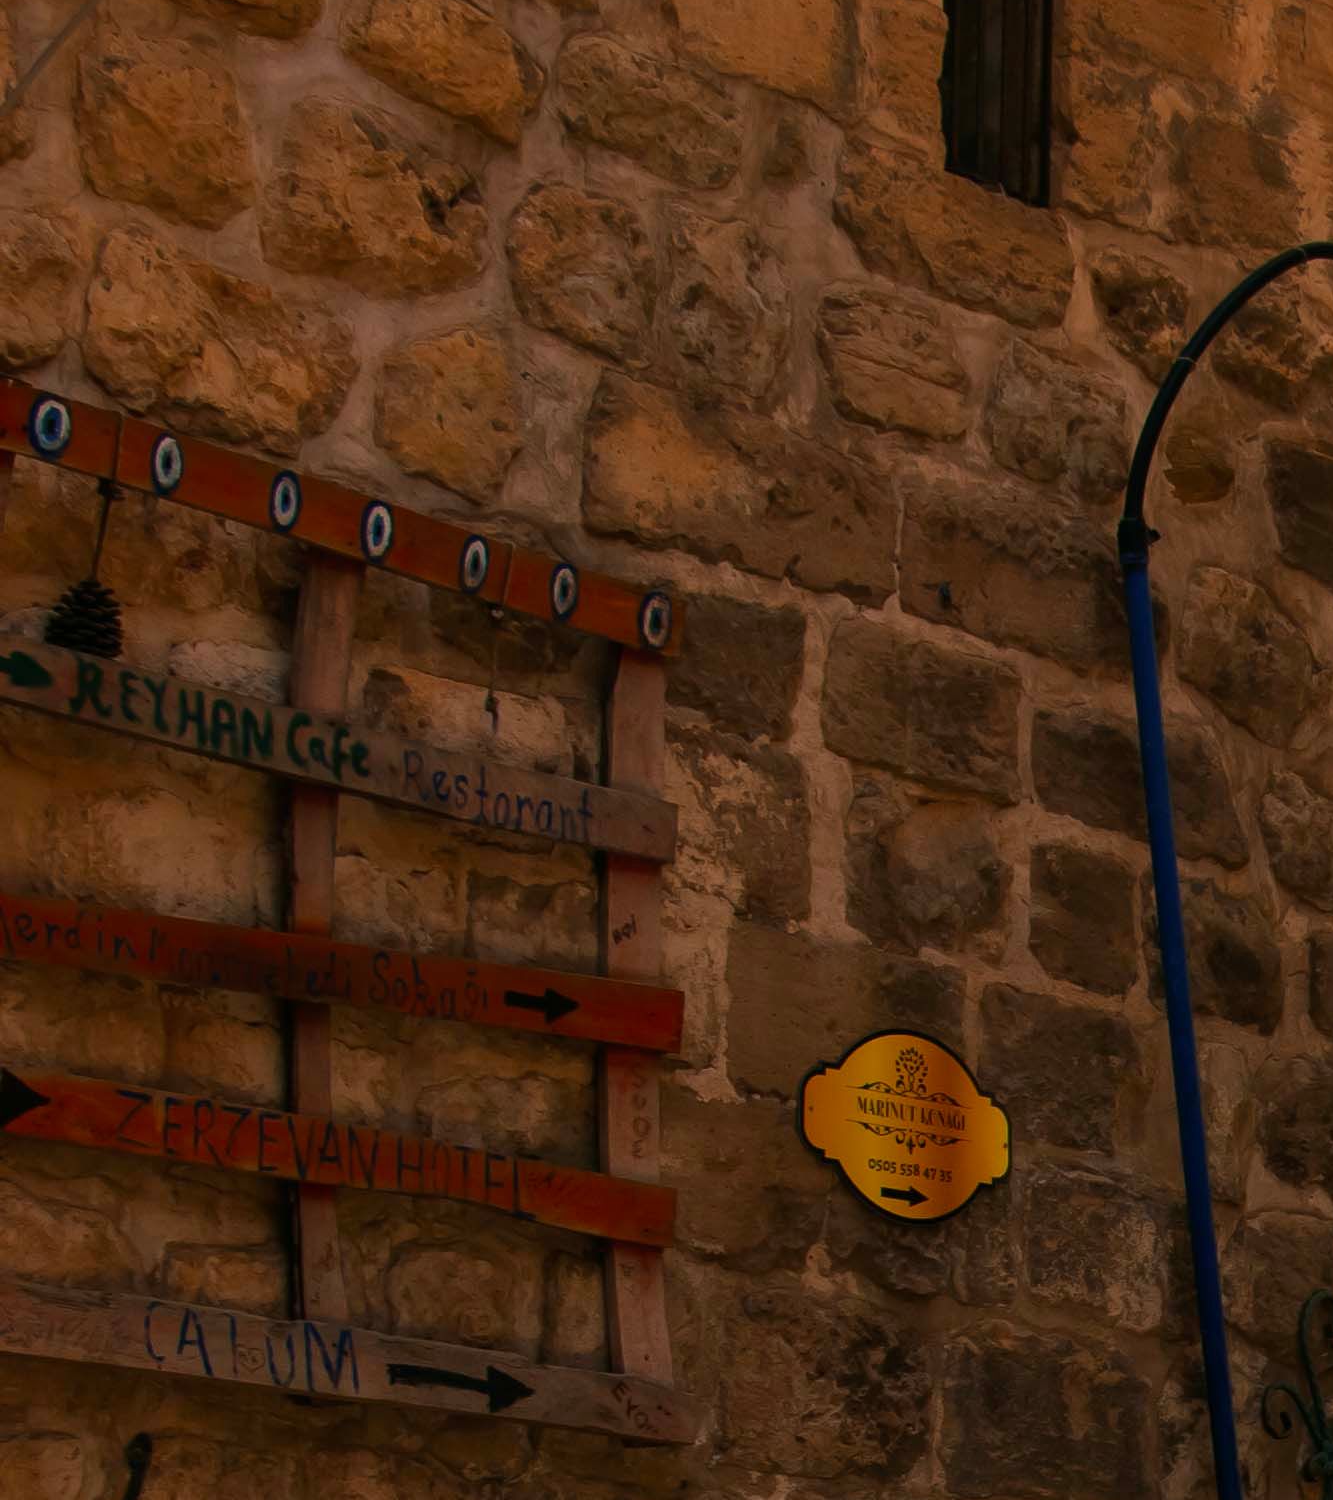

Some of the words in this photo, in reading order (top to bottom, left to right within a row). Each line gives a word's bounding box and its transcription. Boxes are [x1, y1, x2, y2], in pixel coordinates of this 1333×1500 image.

[71, 645, 274, 757] REYHAN
[286, 716, 373, 782] Cafe
[402, 749, 597, 842] Restorant
